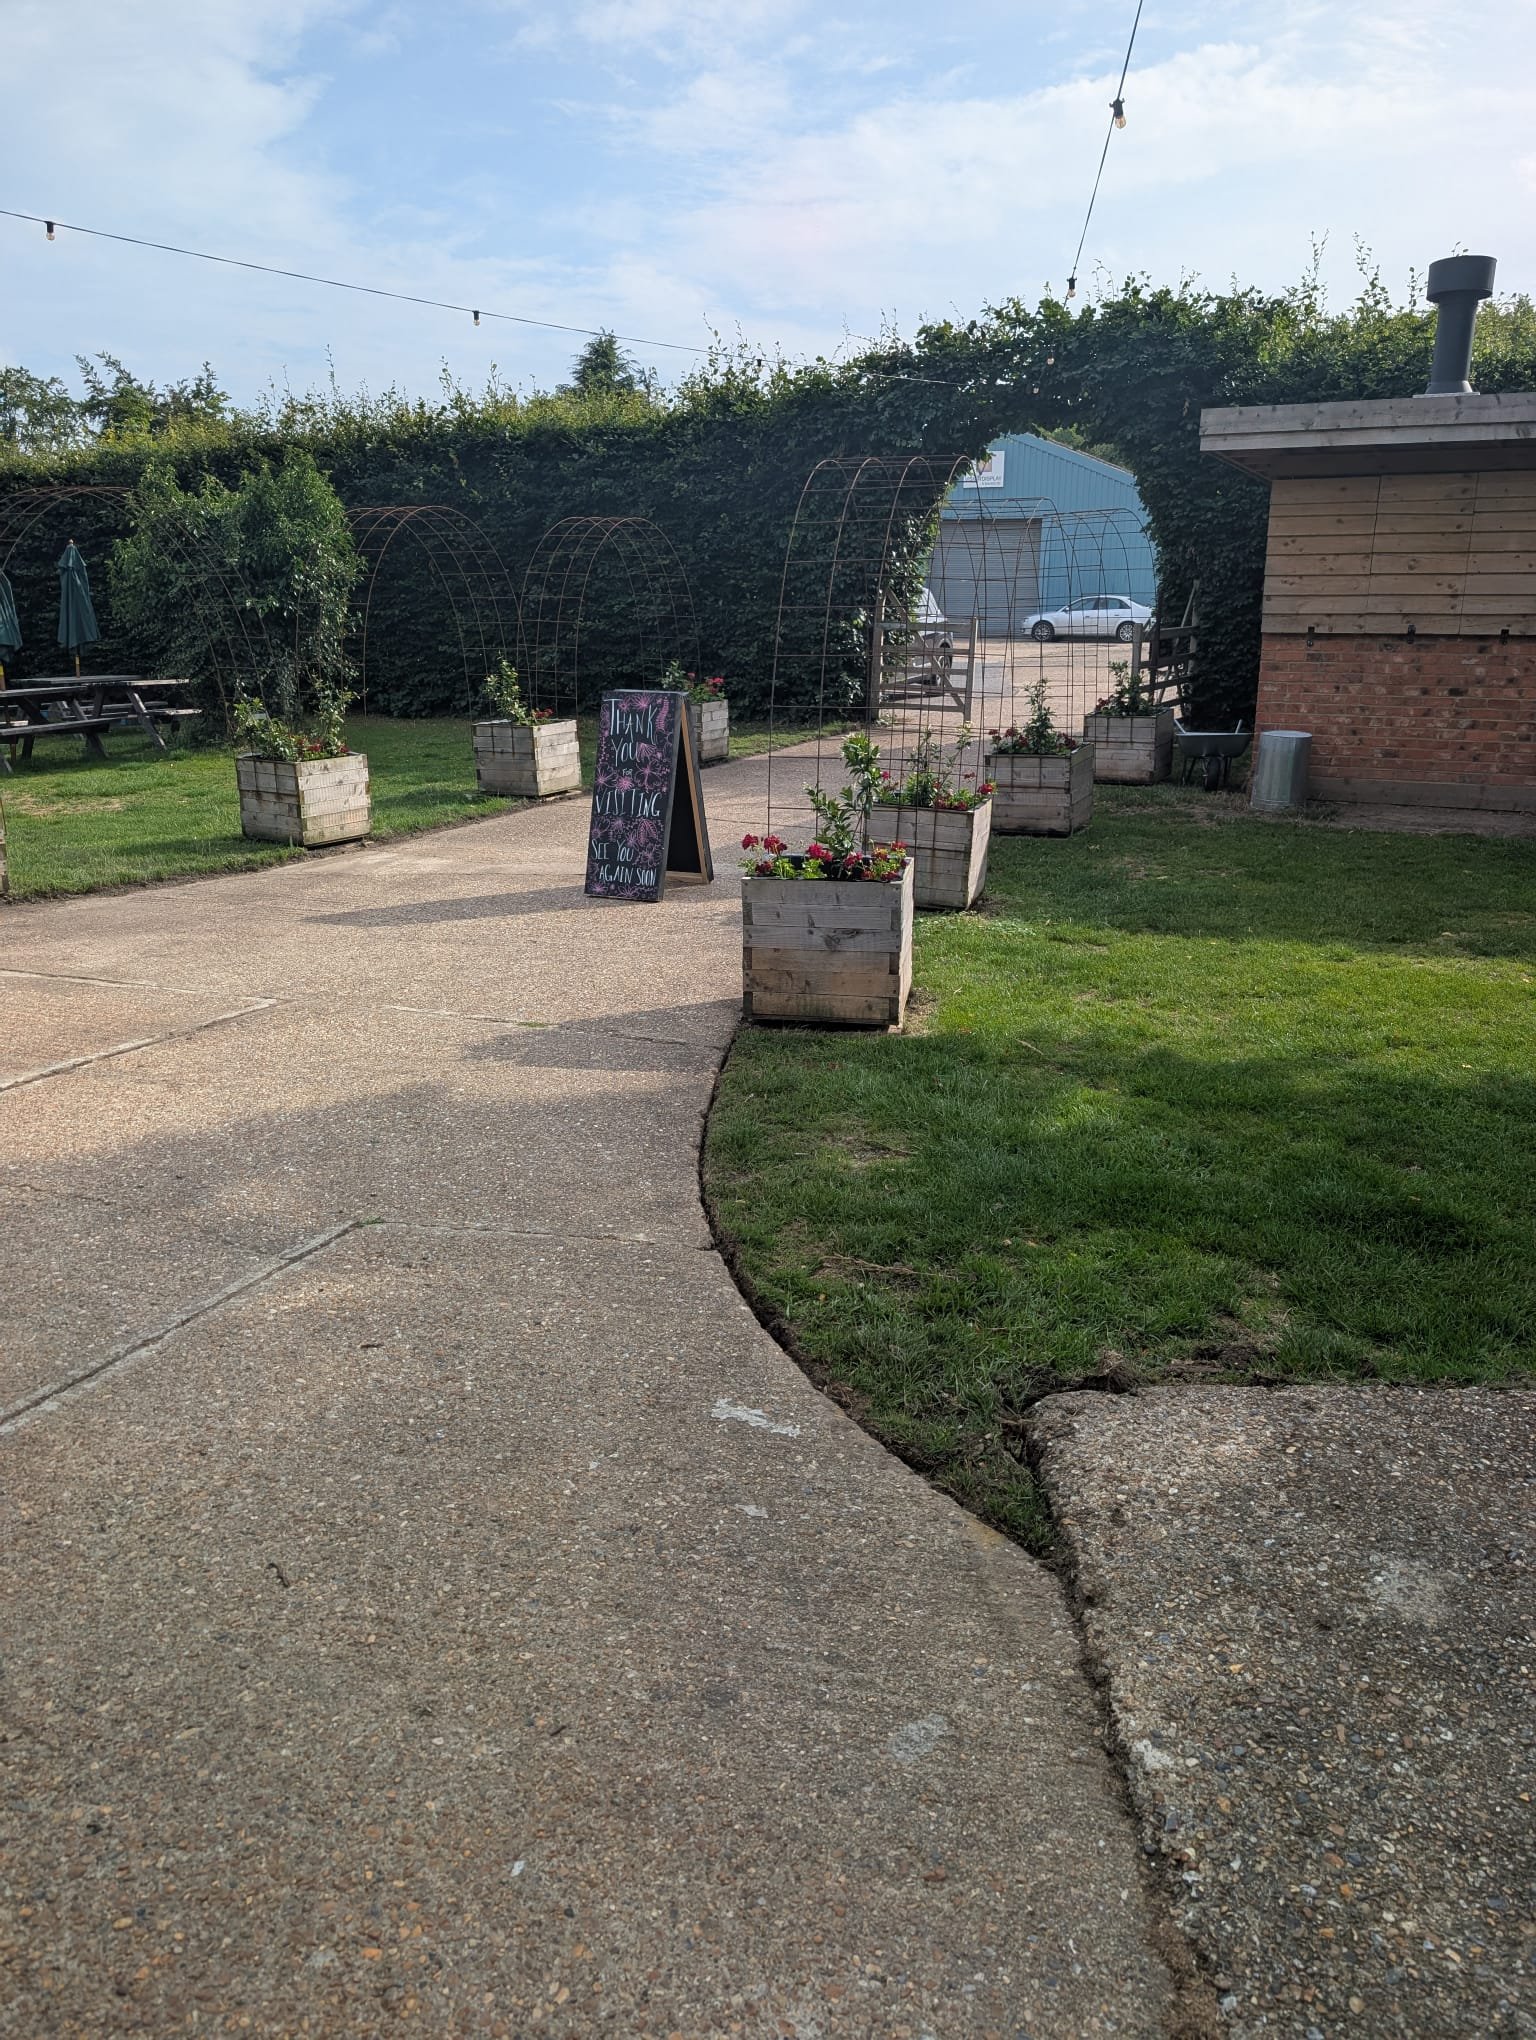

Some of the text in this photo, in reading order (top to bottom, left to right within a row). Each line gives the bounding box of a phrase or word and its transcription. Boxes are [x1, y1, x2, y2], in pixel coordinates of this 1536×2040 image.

[604, 698, 658, 745] THANK
[611, 738, 640, 767] YOU
[622, 768, 633, 776] FOR
[595, 788, 661, 817] VISITING
[591, 839, 635, 861] SEE YOU
[599, 863, 657, 887] AGAIN SOON
